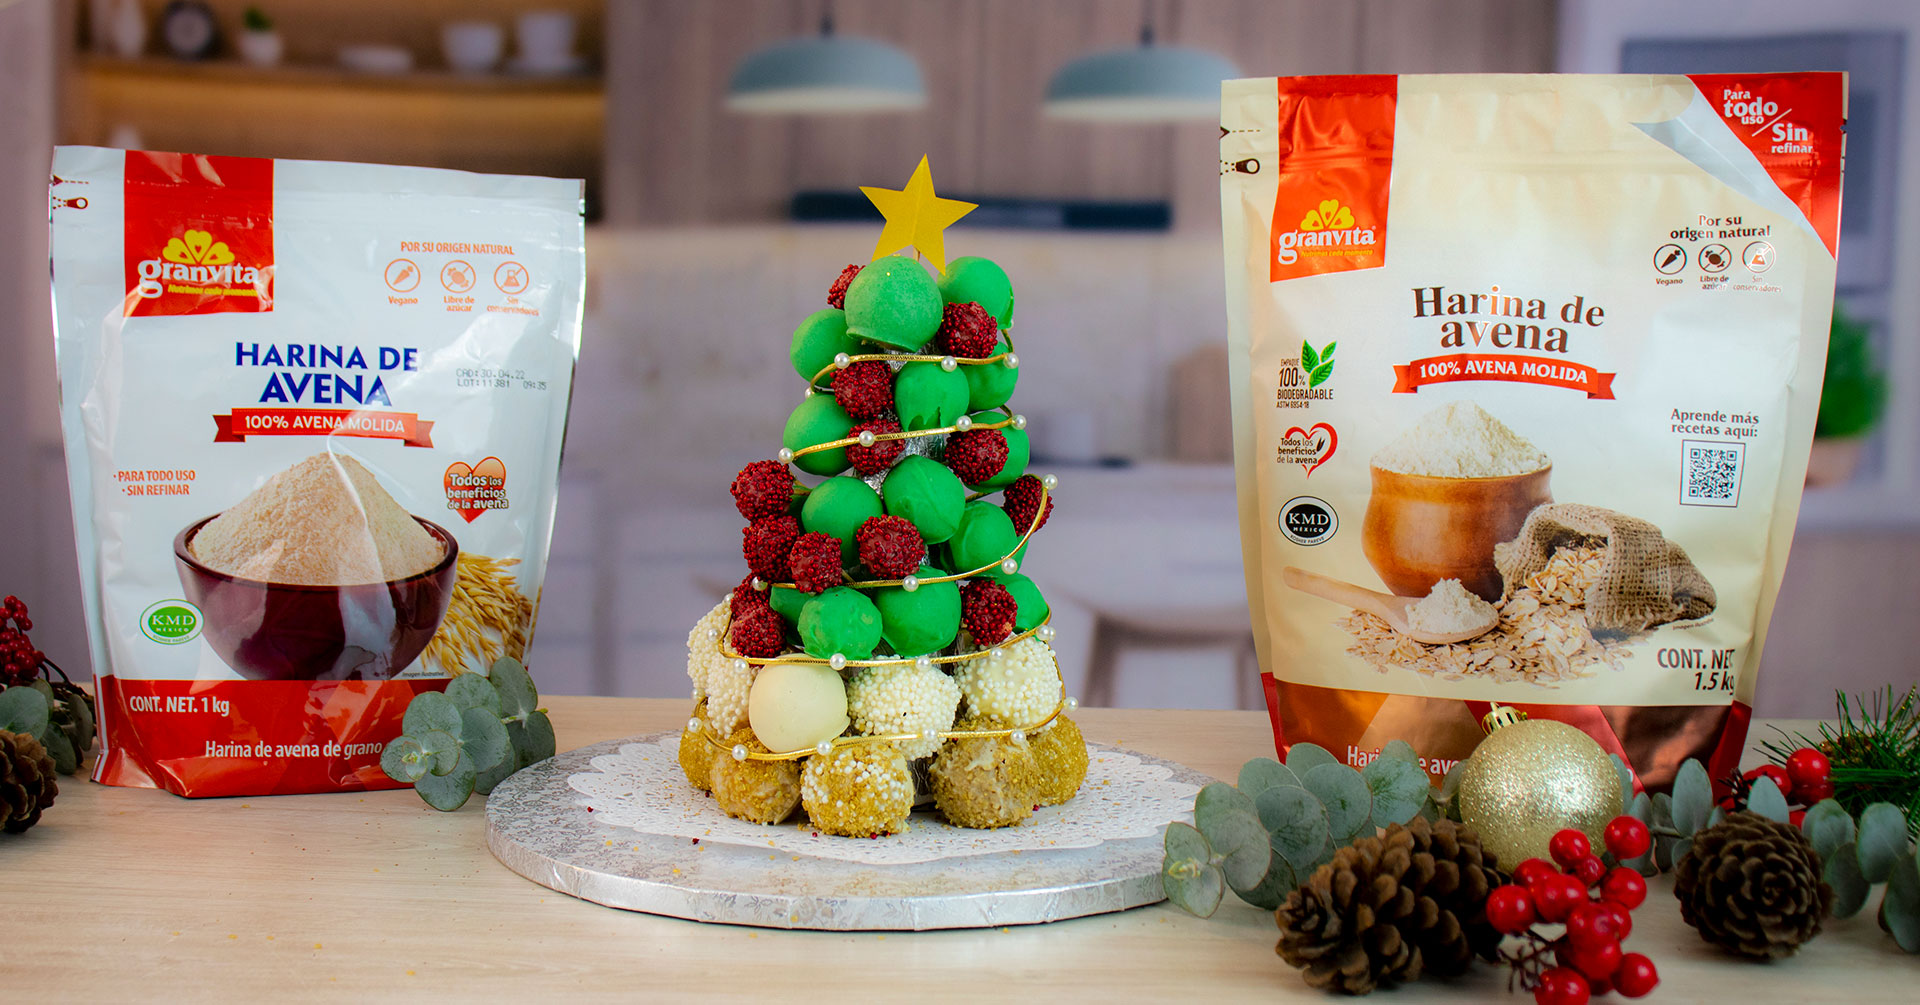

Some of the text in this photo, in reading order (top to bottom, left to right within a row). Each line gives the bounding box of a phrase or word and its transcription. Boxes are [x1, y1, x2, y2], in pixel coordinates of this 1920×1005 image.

[1723, 89, 1751, 101] Para
[1724, 97, 1778, 118] todo
[1741, 115, 1764, 125] uso
[1772, 123, 1808, 142] Sin
[1771, 143, 1813, 154] refinar
[1699, 215, 1742, 226] Por su
[1670, 226, 1771, 241] origen natural
[400, 241, 515, 255] POR SU ORIGEN NATURAL
[1278, 227, 1376, 265] granvita
[137, 256, 258, 298] granvita
[1655, 277, 1683, 286] Vegano
[1751, 275, 1762, 283] Sin
[1732, 284, 1782, 292] conservadores
[388, 295, 418, 306] Vegano
[443, 295, 475, 304] Libre de
[506, 296, 519, 305] Sin
[1411, 285, 1605, 327] Harina de
[446, 304, 472, 312] azúcar
[1440, 320, 1569, 353] avena
[235, 341, 418, 372] HARINA DE
[1279, 367, 1306, 387] 100%
[1419, 360, 1588, 384] 100% AVENA MOLIDA
[258, 371, 393, 407] AVENA
[1277, 388, 1334, 400] BIODEGRADABLE
[1670, 408, 1759, 424] Aprende más
[245, 415, 405, 433] 100% AVENA MOLIDA
[1671, 423, 1758, 439] recetas aquí:
[1280, 437, 1314, 446] Todos los
[1278, 446, 1317, 455] beneficios
[1277, 455, 1286, 464] de
[1286, 455, 1294, 464] la
[118, 470, 196, 482] PARA TODO USO
[450, 473, 502, 486] Todos los
[127, 484, 190, 496] SIN REFINAR
[447, 487, 505, 498] beneficios
[448, 500, 508, 509] de la avena
[1289, 512, 1329, 526] KMD
[152, 615, 195, 625] KMD
[1657, 648, 1707, 669] CONT.
[1695, 671, 1719, 690] 1.5
[130, 696, 230, 716] CONT. NET. 1 kg
[206, 741, 382, 760] Harina de avena de grano
[1347, 745, 1379, 767] Hari
